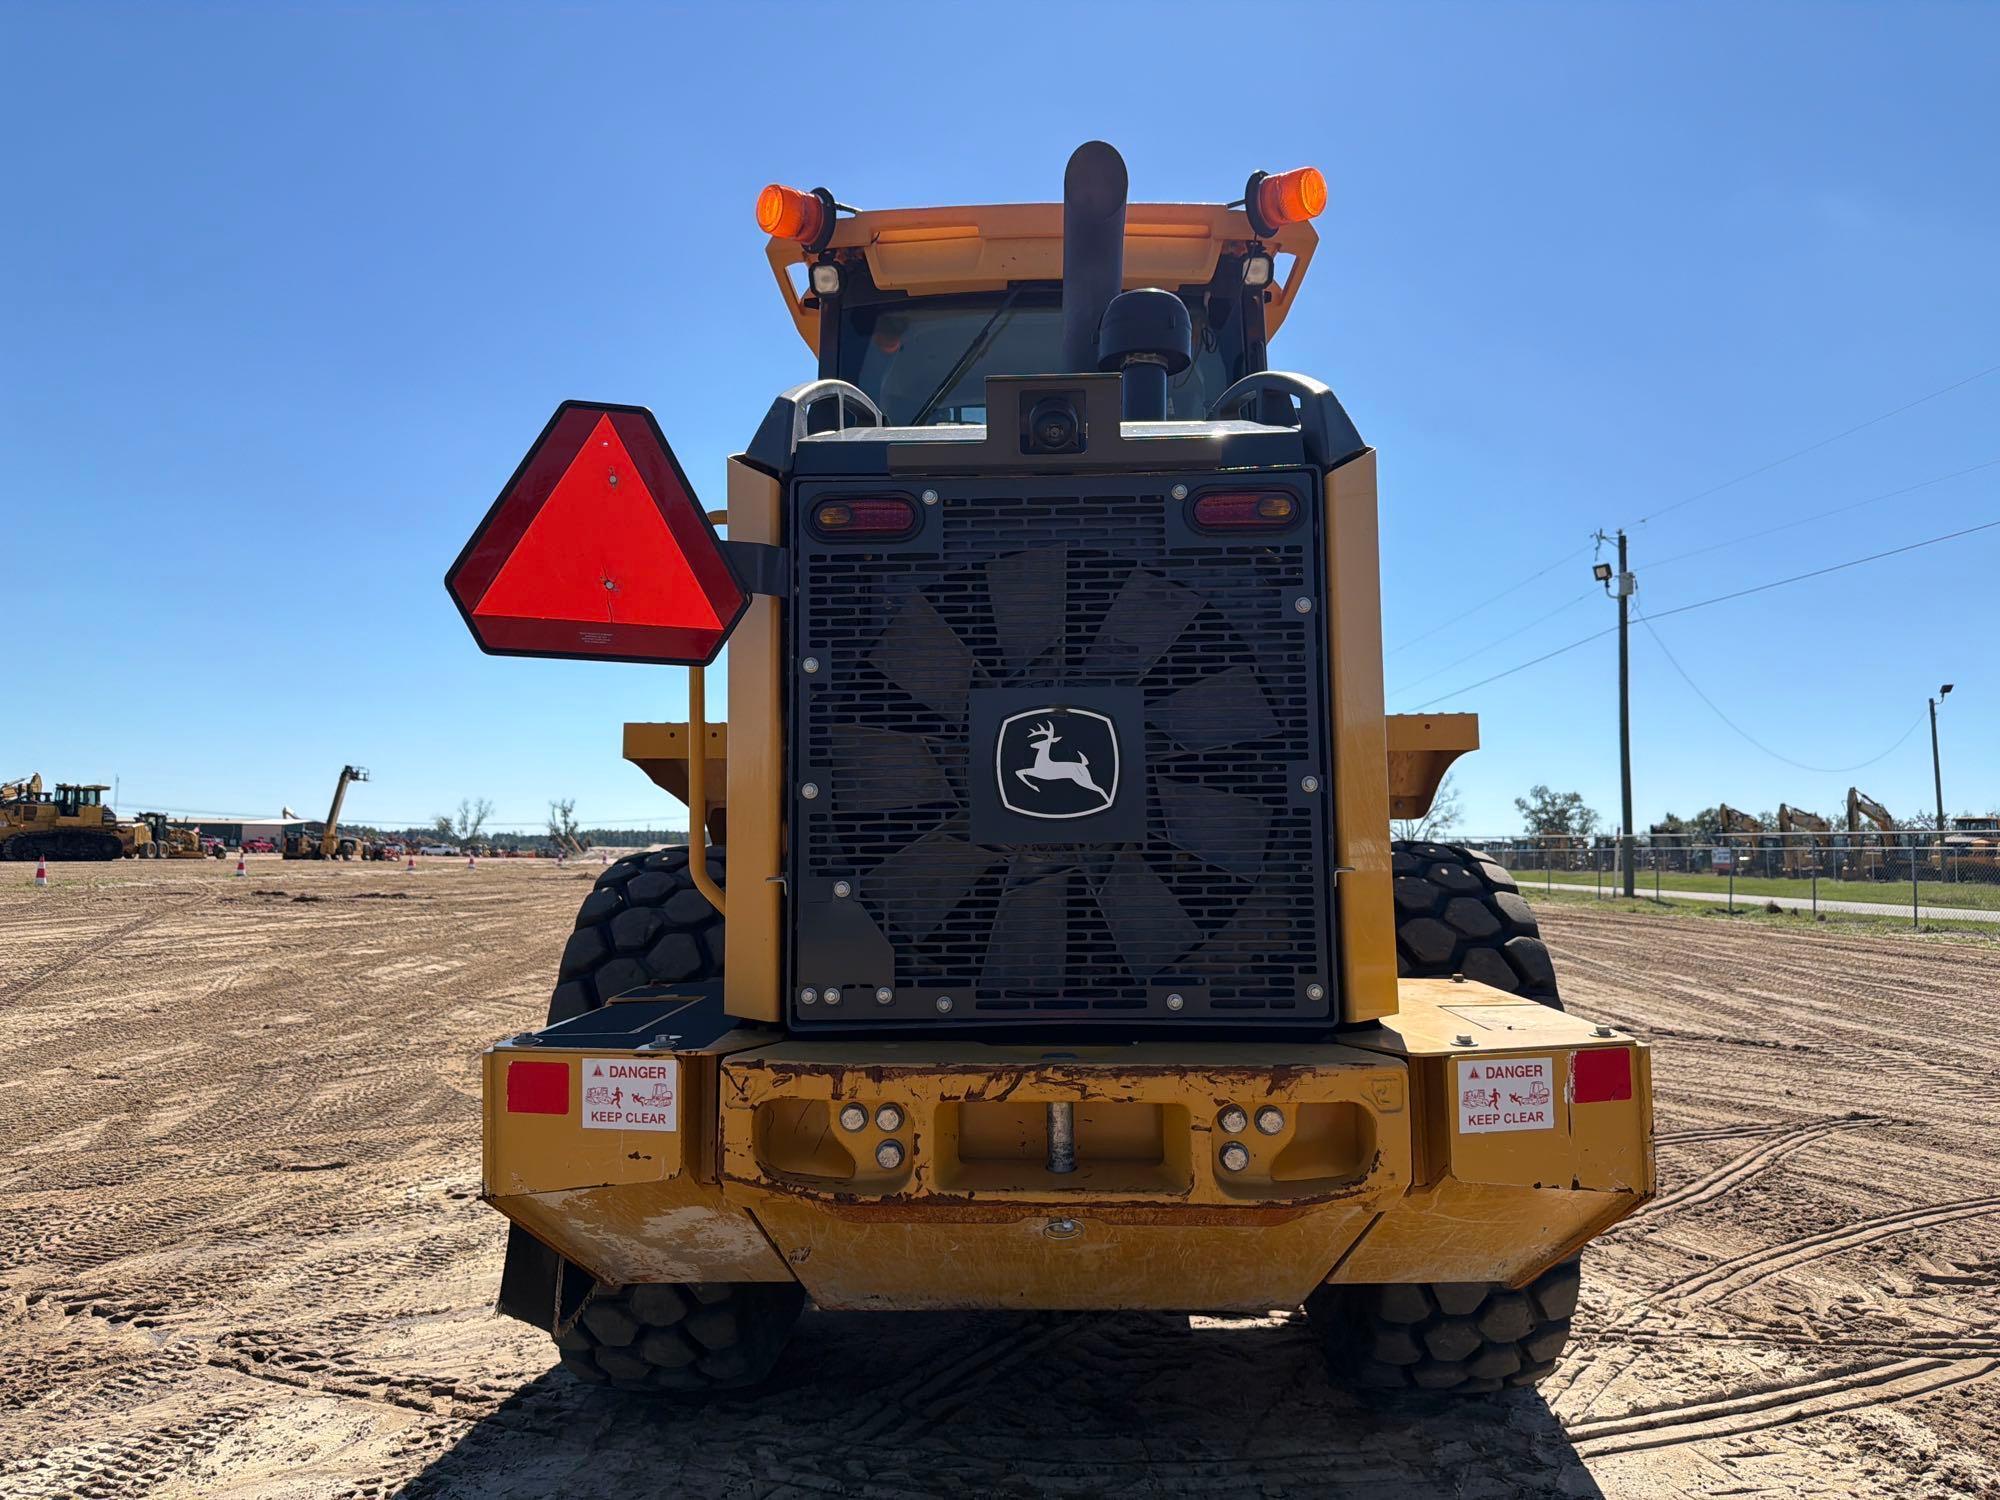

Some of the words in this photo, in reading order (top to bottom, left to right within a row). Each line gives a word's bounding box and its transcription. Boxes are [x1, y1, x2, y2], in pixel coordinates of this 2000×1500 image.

[609, 1065, 667, 1079] DANGER
[1486, 1065, 1543, 1079] DANGER
[591, 1111, 622, 1123] KEEP
[625, 1112, 666, 1124] CLEAR
[1468, 1113, 1500, 1126] KEEP
[1503, 1111, 1544, 1124] CLEAR
